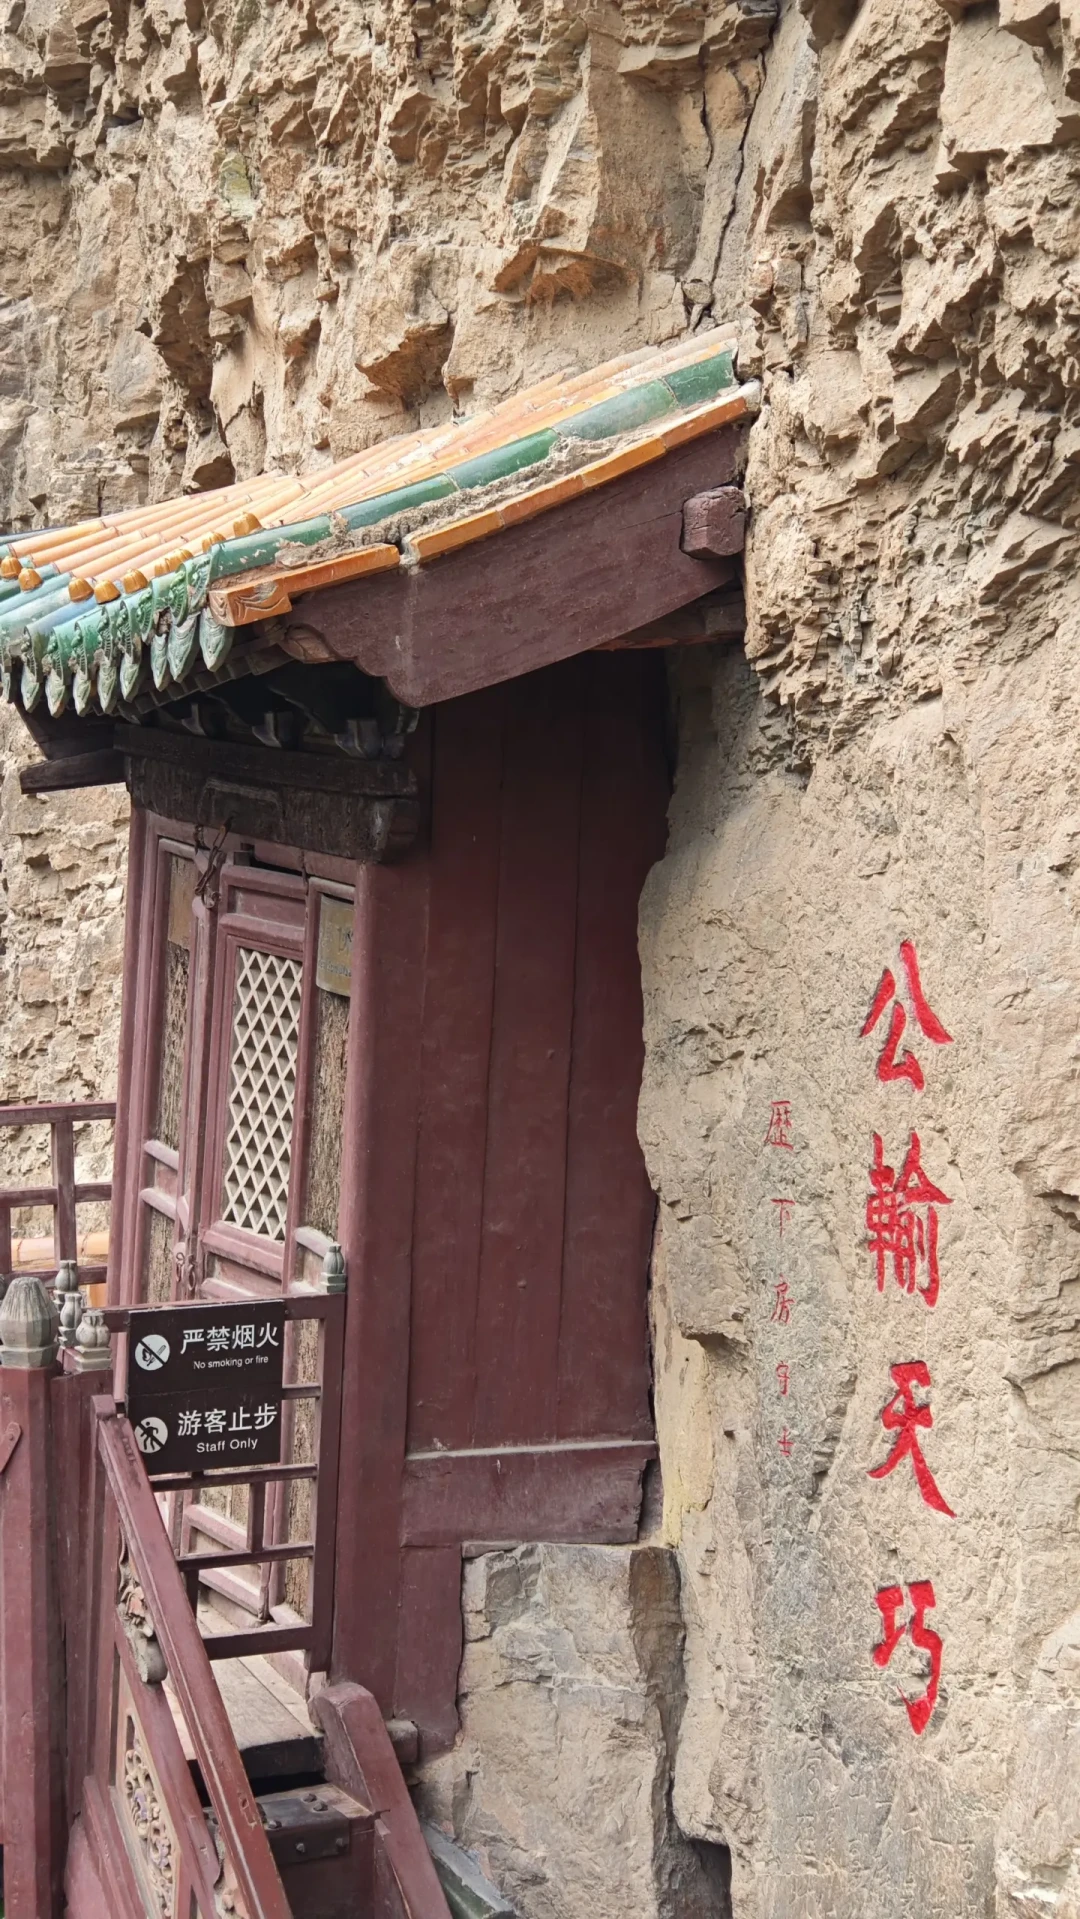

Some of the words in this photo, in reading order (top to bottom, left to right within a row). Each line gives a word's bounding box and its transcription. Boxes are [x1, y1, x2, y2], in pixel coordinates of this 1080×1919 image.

[180, 1322, 279, 1354] 严禁烟火
[193, 1360, 206, 1370] No
[207, 1357, 243, 1369] smoking
[244, 1357, 254, 1365] or
[255, 1355, 269, 1365] fire
[177, 1402, 278, 1436] 游客止步
[196, 1440, 225, 1453] Staff
[229, 1437, 258, 1450] Only
